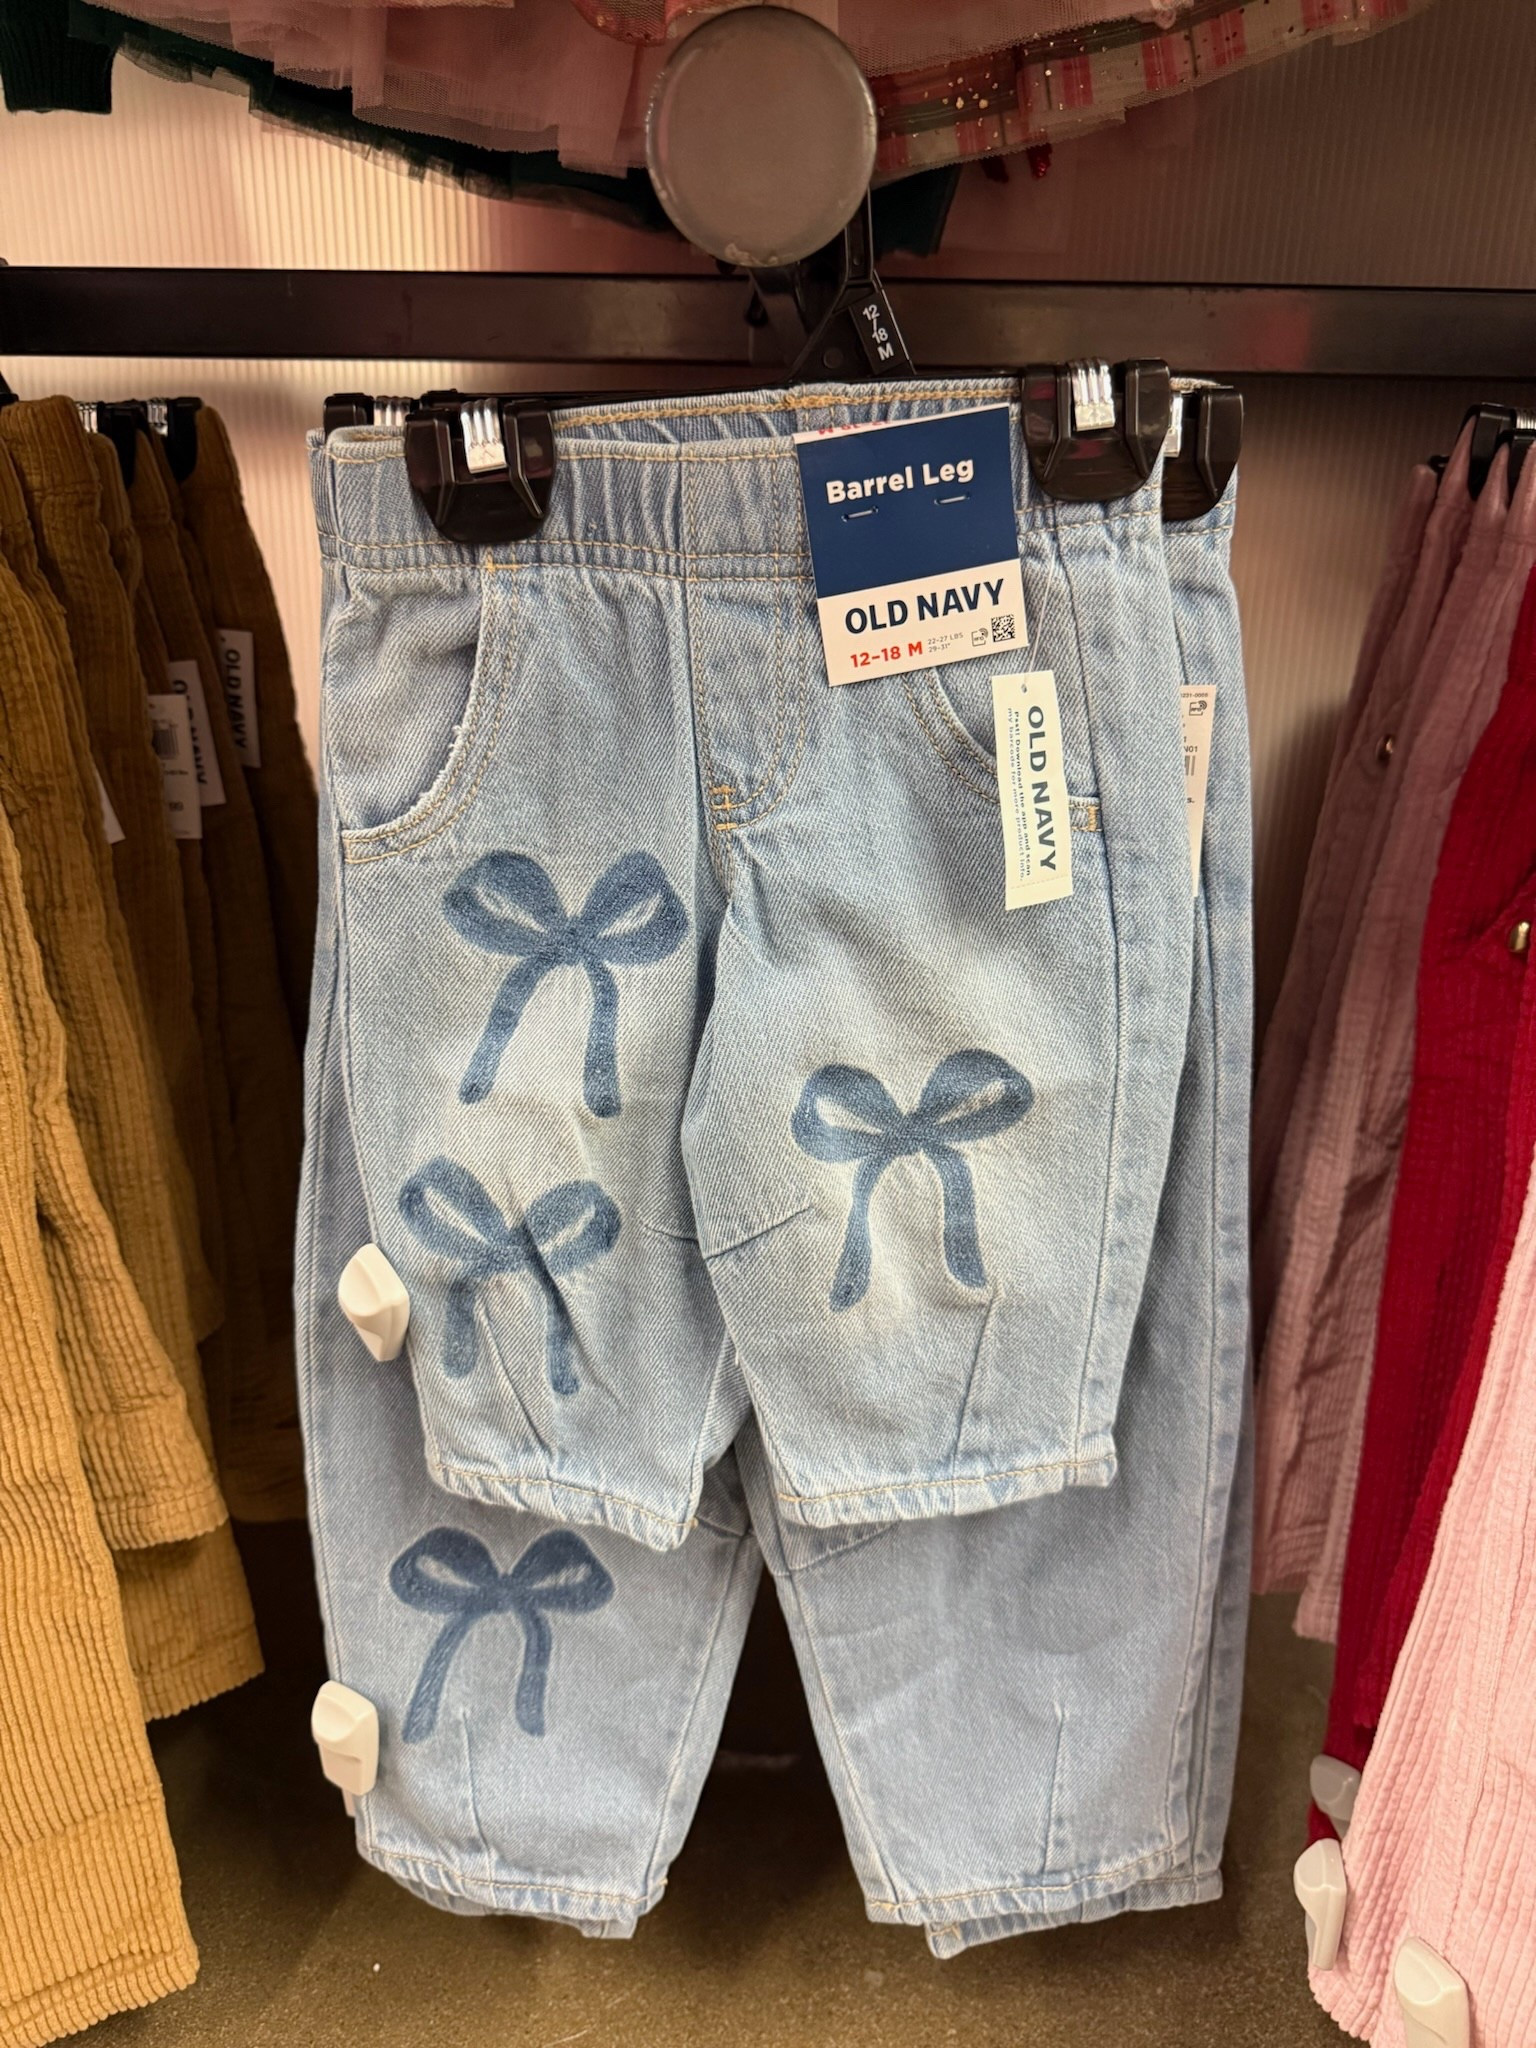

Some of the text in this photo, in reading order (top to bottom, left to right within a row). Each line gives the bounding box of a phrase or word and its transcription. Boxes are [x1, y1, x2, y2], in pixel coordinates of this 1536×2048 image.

[862, 304, 880, 321] 12
[871, 328, 888, 344] 18
[877, 343, 894, 361] M
[826, 459, 975, 504] Barrel Leg
[845, 578, 1004, 635] OLD NAVY
[225, 649, 241, 689] OLD
[850, 641, 923, 668] 12-18 M
[1028, 705, 1056, 871] OLD NAVY
[1016, 817, 1024, 856] product
